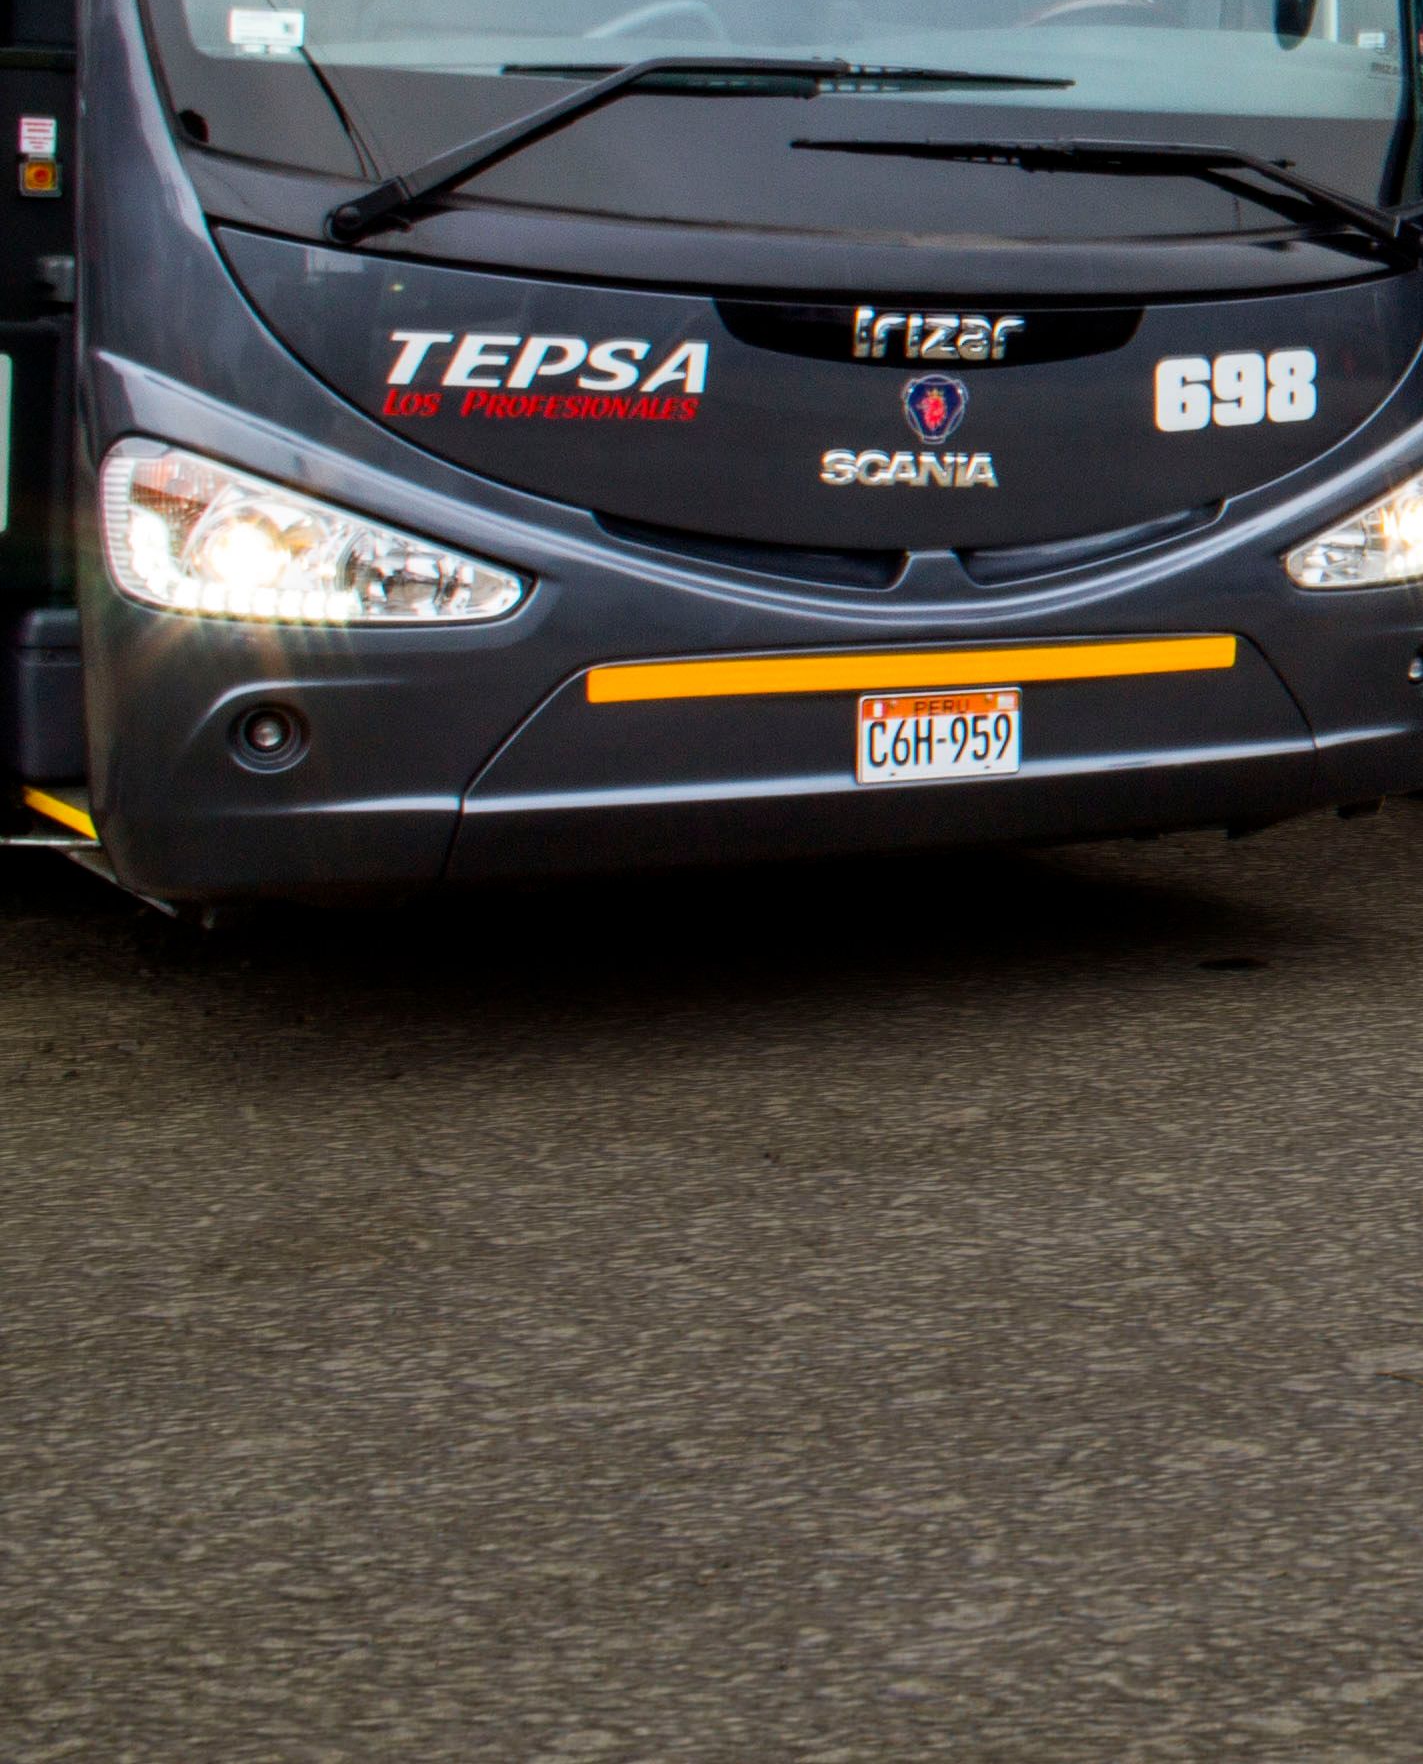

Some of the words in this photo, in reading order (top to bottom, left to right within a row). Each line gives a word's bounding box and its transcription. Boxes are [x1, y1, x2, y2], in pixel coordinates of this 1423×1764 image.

[386, 331, 709, 394] TEPSA
[1154, 346, 1318, 433] 698
[818, 448, 999, 488] SCANIA
[913, 697, 970, 716] PERU
[868, 712, 1012, 768] C6H-959
